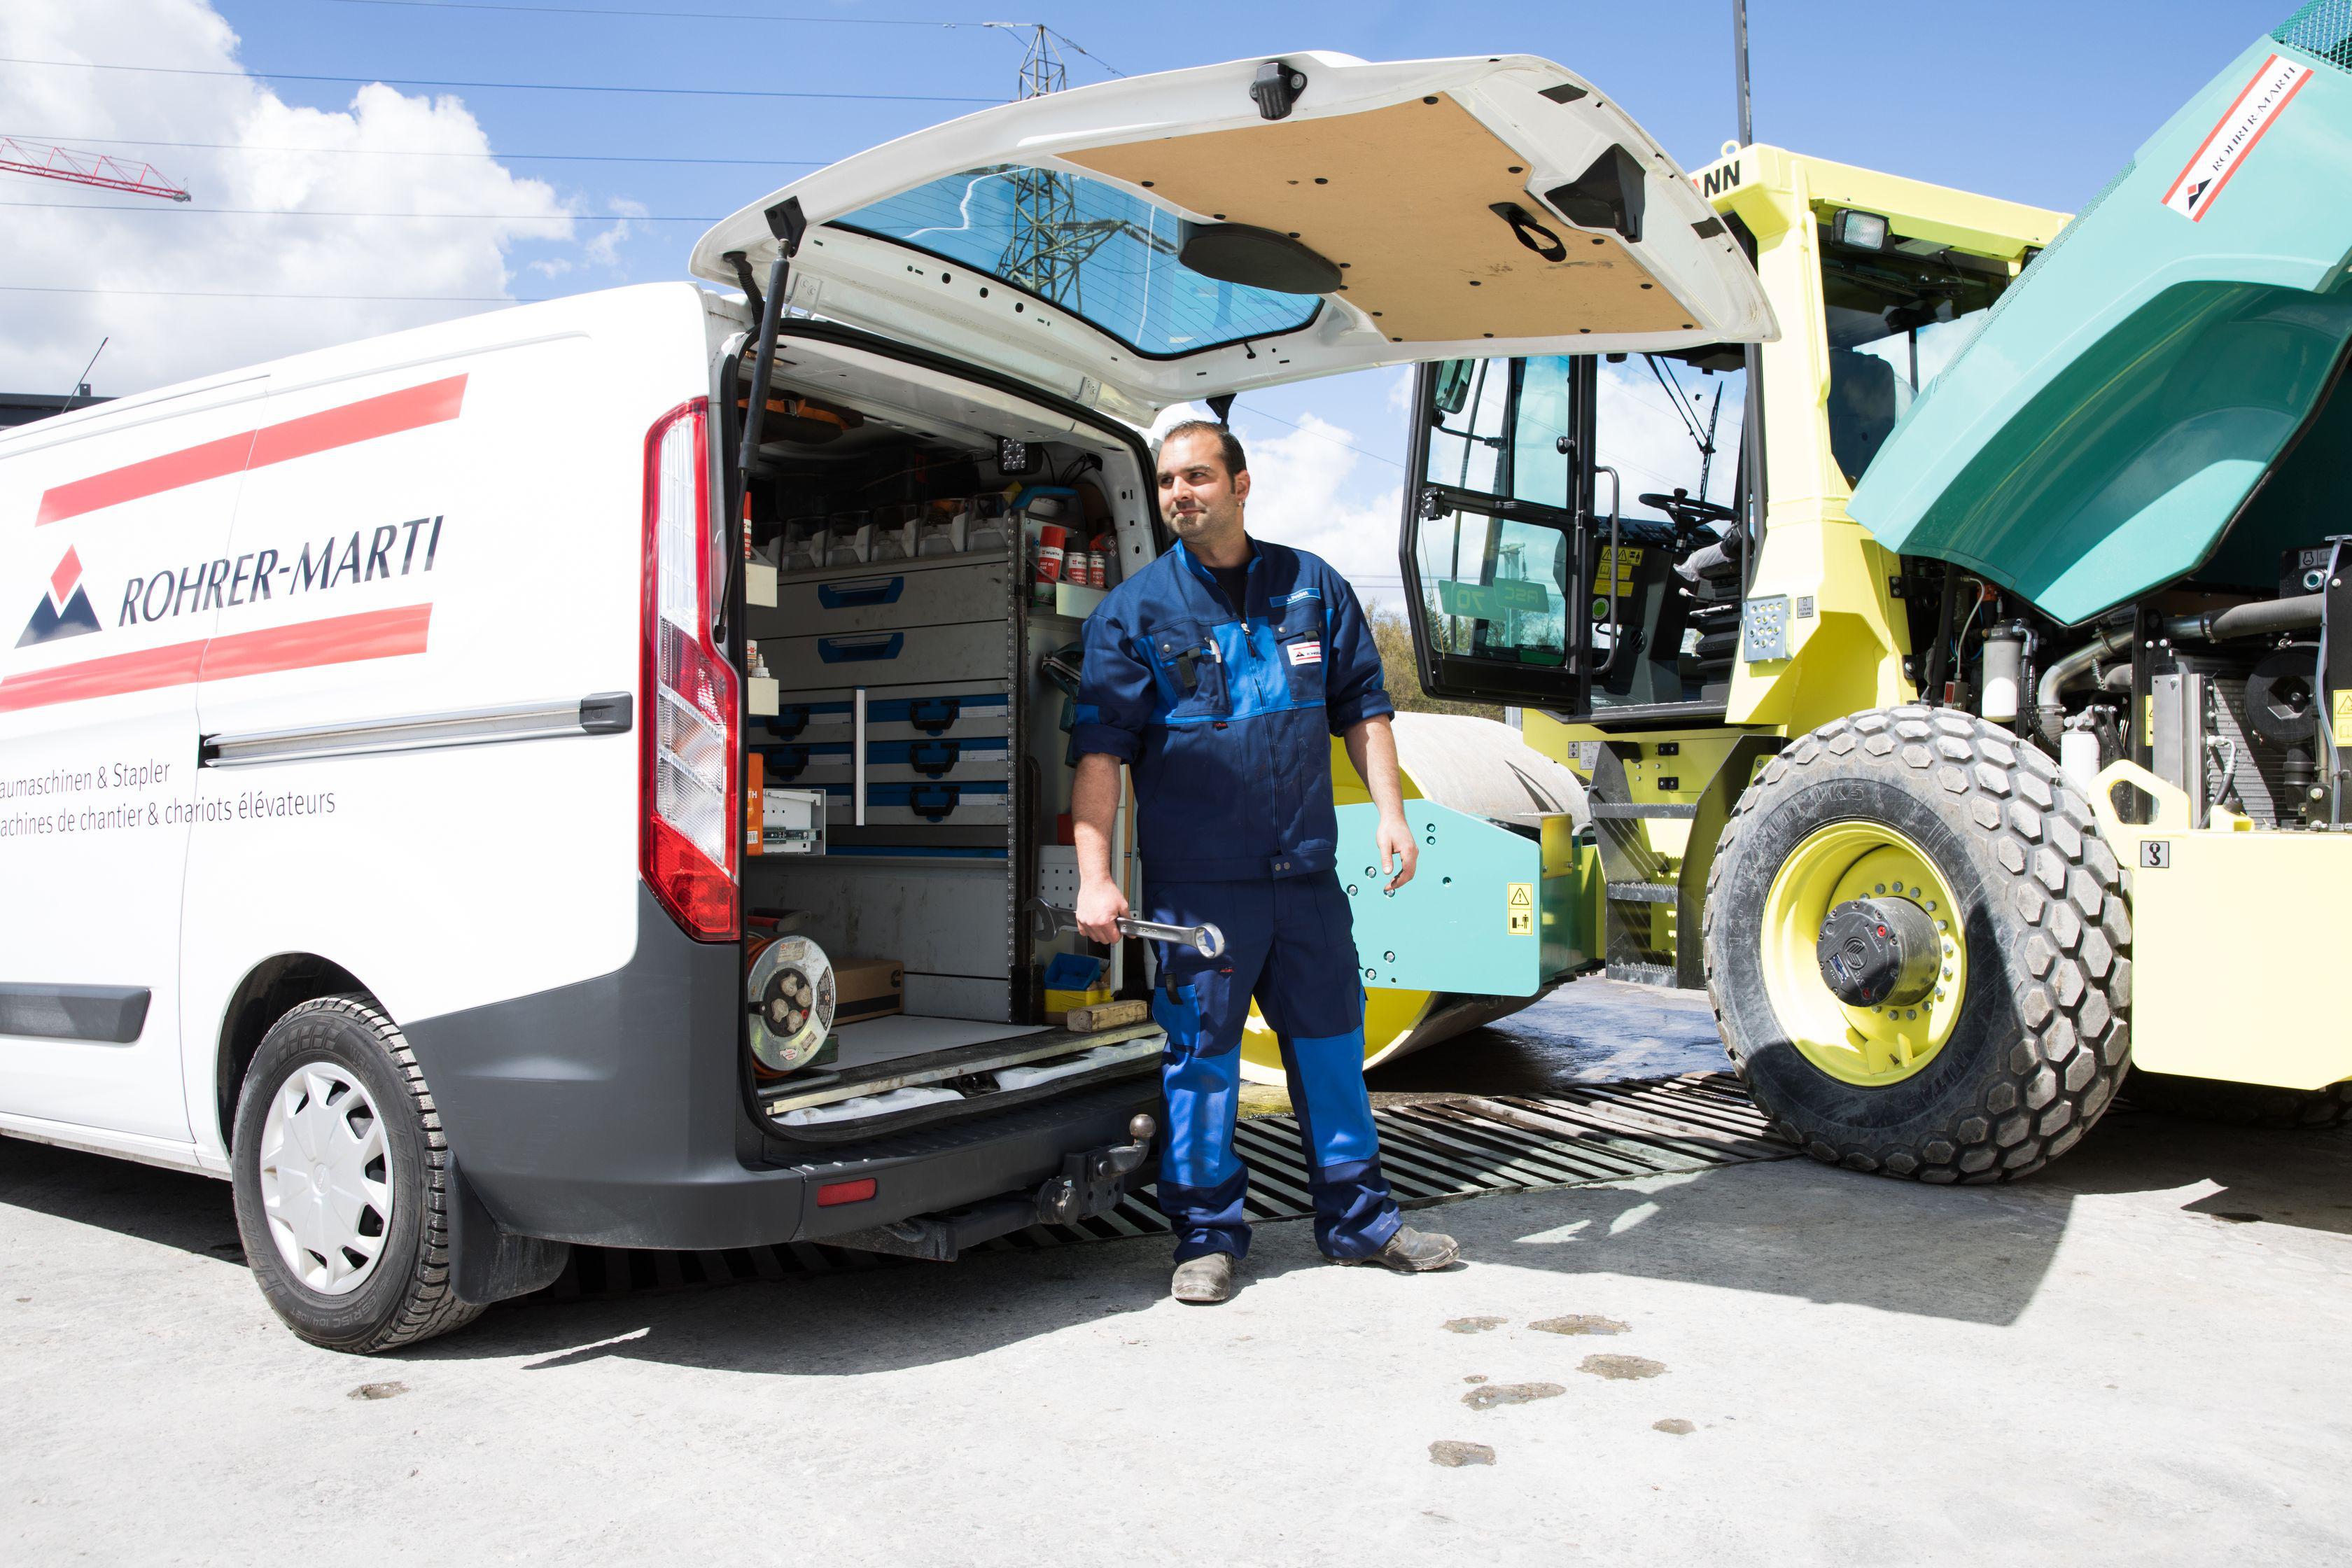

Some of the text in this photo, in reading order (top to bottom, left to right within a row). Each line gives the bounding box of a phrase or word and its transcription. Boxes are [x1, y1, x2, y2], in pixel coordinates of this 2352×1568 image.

[2211, 66, 2296, 172] ROHRER-MARTI
[1691, 160, 1740, 198] NN
[118, 514, 444, 627] ROHRER-MARTI
[0, 758, 170, 799] aumaschinen & Stapler
[0, 790, 336, 837] achines de chantier & chariots élévateurs
